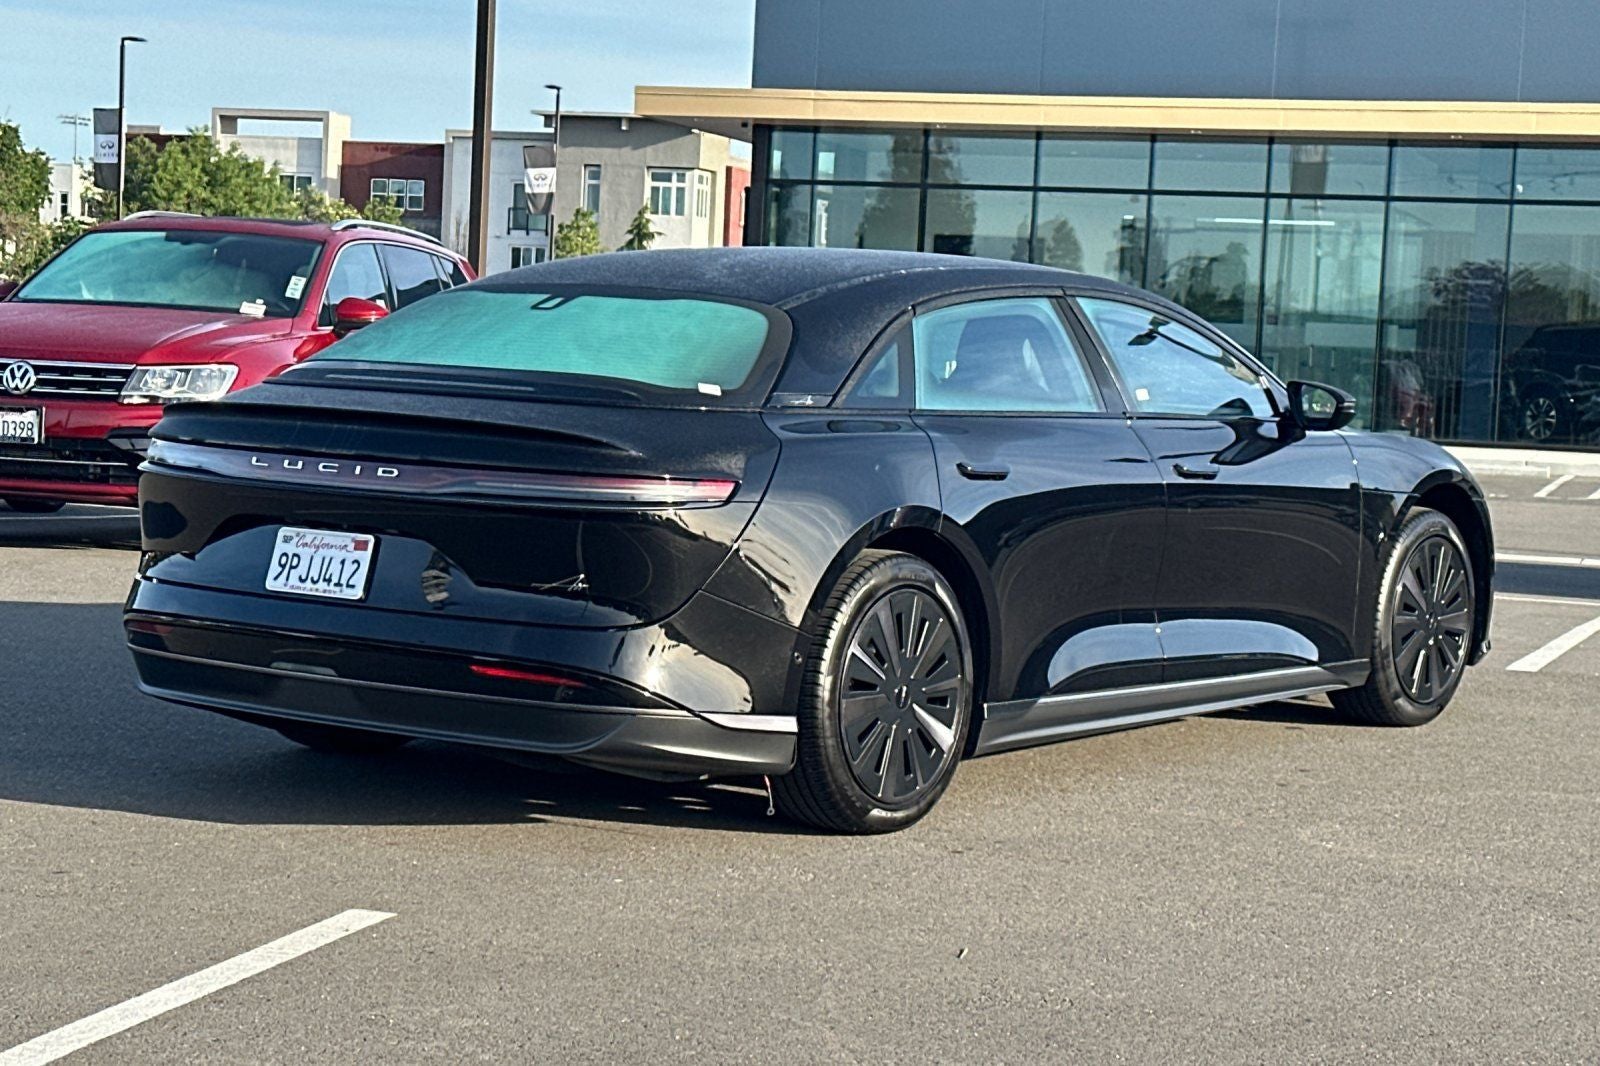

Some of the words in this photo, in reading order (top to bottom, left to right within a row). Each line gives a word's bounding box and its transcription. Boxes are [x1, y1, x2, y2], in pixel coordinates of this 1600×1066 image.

[3, 421, 34, 437] D398
[251, 456, 399, 477] LUCID
[296, 534, 354, 554] California
[273, 552, 361, 589] 9PJJ412
